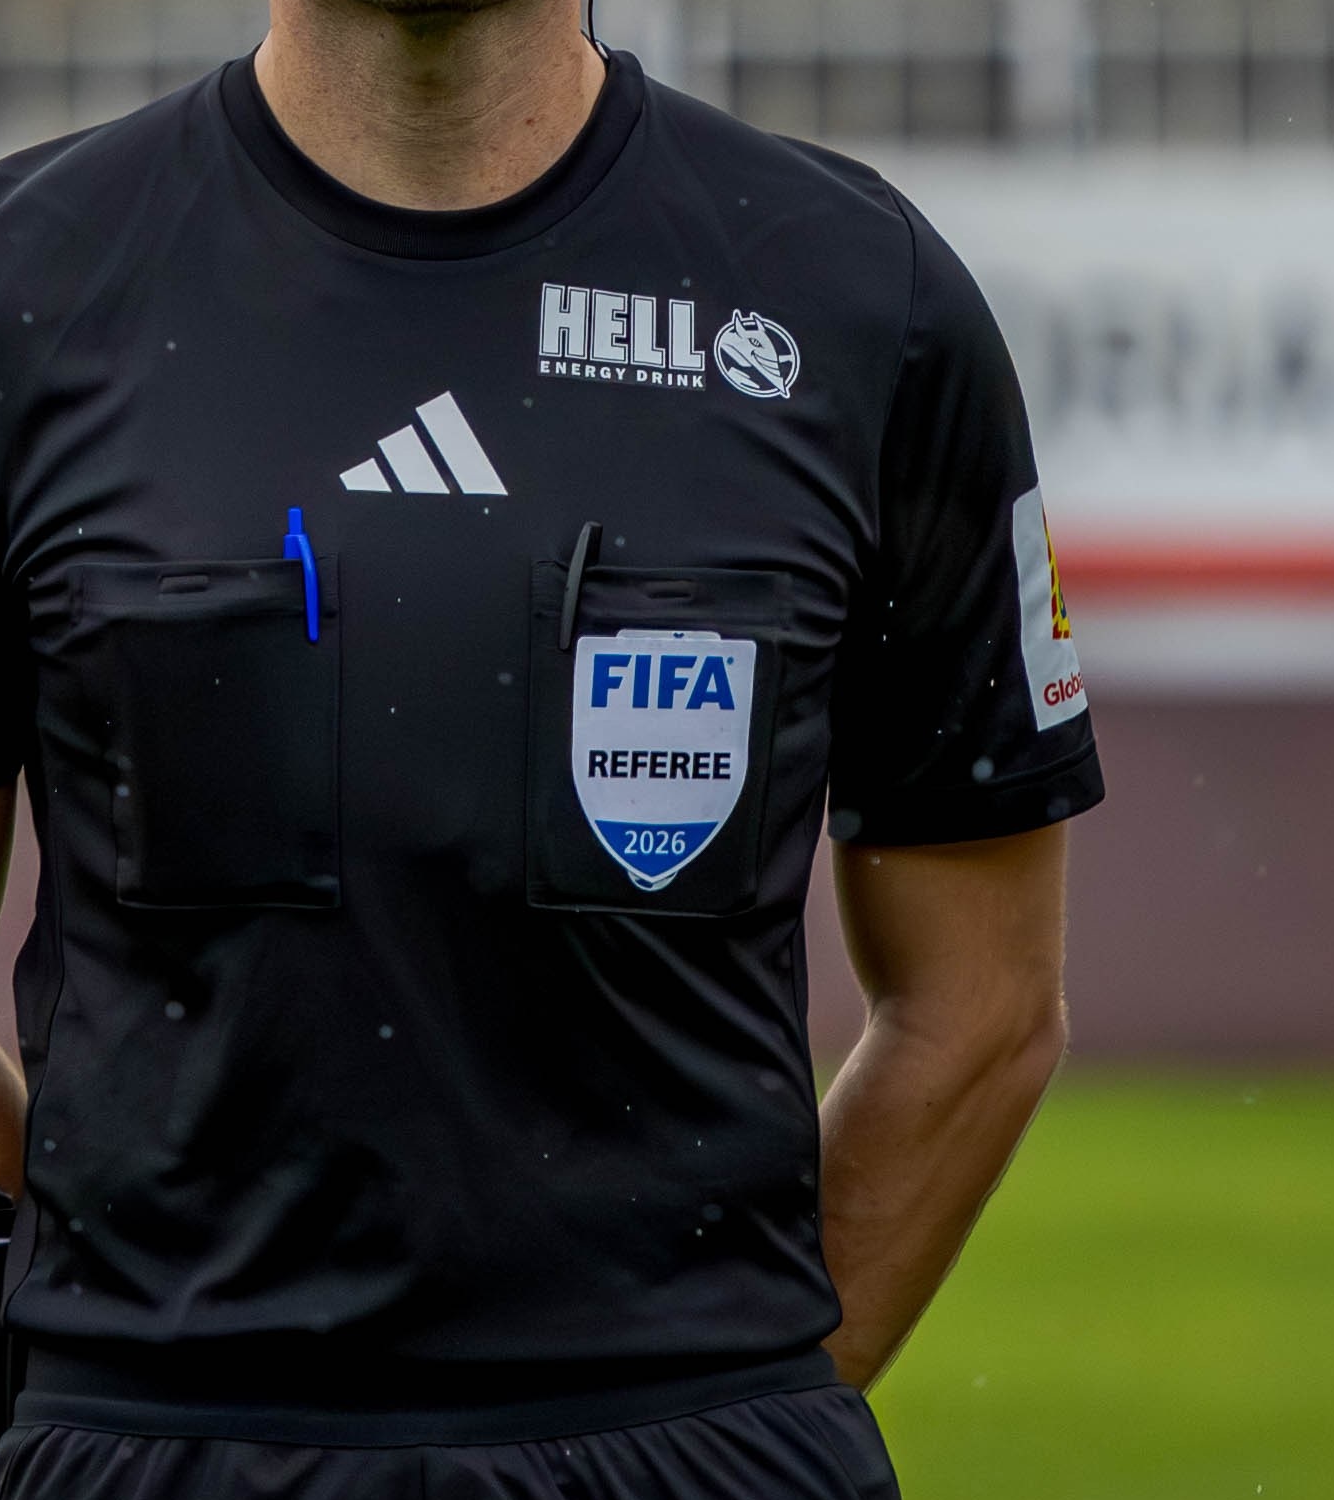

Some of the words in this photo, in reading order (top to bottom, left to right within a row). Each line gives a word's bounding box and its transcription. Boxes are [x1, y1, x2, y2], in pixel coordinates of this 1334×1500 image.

[538, 282, 706, 371] HELL
[540, 360, 626, 381] ENERGY
[636, 369, 704, 388] DRINK
[590, 653, 735, 711] FIFA
[588, 749, 731, 780] REFEREE
[624, 830, 686, 854] 2026
